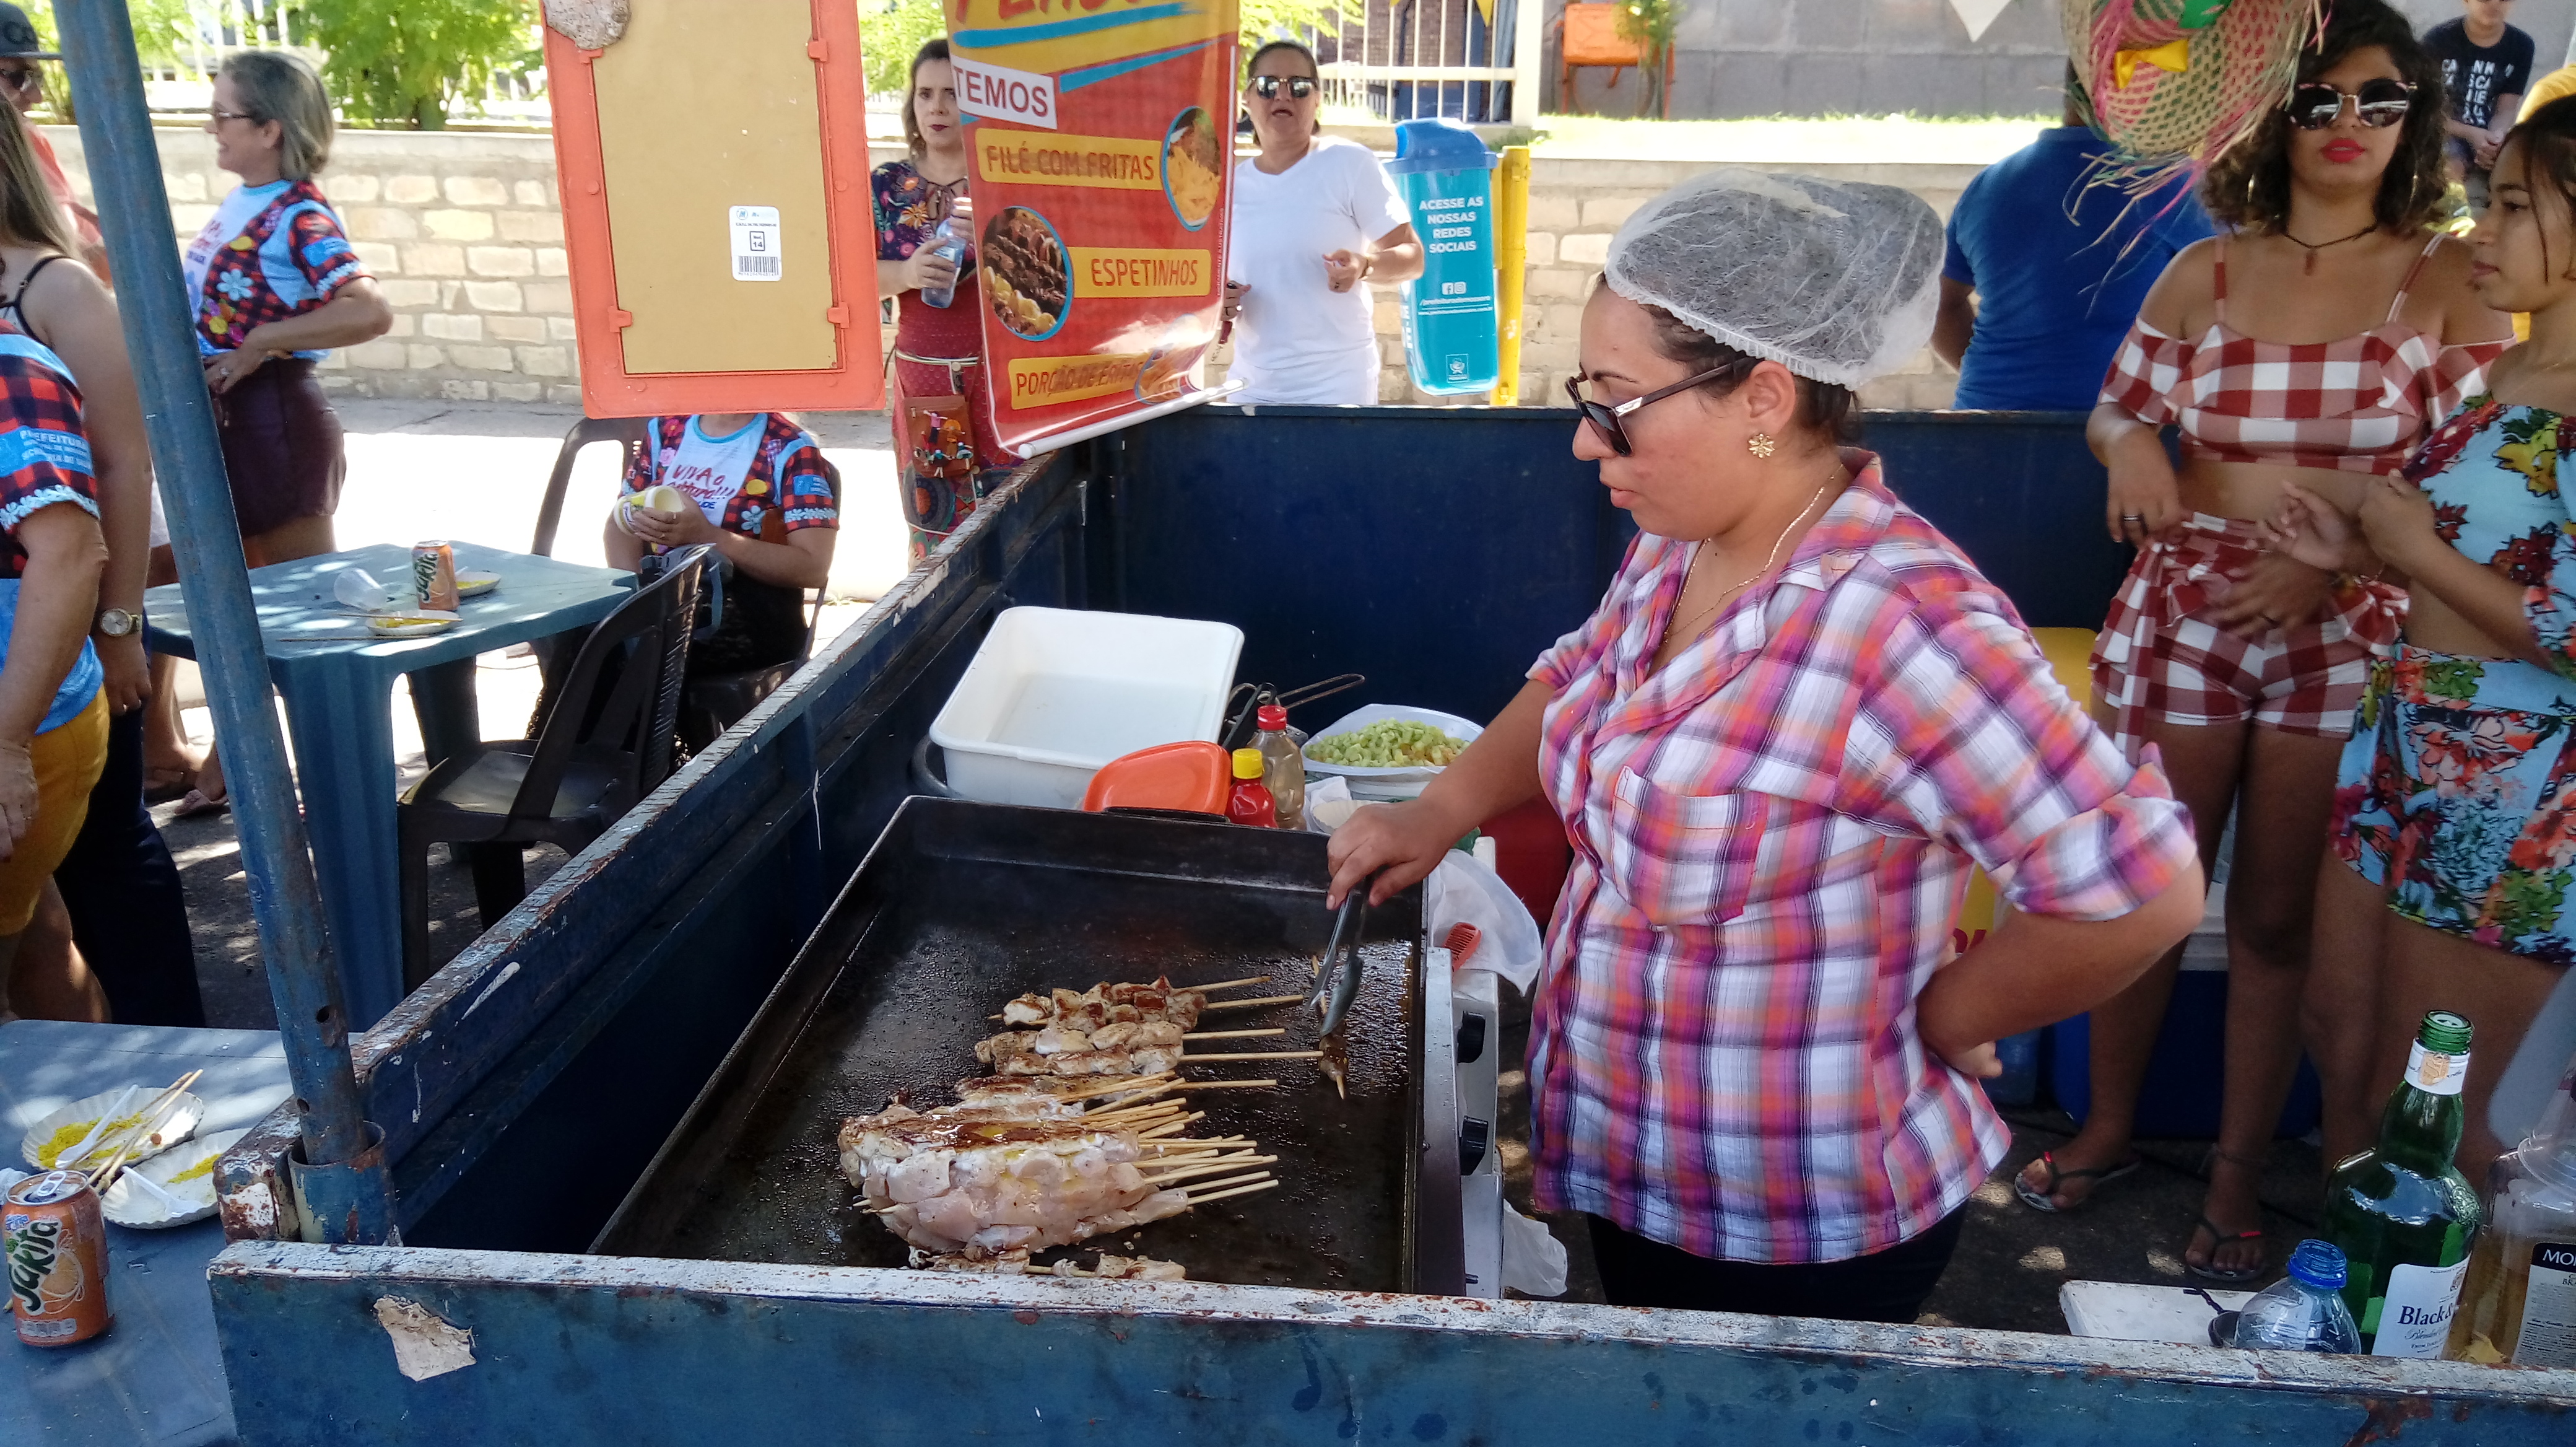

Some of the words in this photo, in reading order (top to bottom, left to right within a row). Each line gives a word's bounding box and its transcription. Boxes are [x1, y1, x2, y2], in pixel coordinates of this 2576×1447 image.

[953, 66, 1048, 117] TEMOS
[986, 141, 1031, 175] FILÉ
[1037, 148, 1082, 177] COM
[1087, 152, 1155, 180] FRITAS
[1419, 198, 1465, 211] ACESSE
[1467, 196, 1484, 208] AS
[1427, 211, 1476, 224] NOSSAS
[1433, 227, 1472, 239] REDES
[1429, 240, 1476, 253] SOCIAIS
[1090, 258, 1198, 288] ESPETINHOS
[1016, 365, 1075, 396] PORÇÃO
[2398, 1305, 2445, 1326] Black
